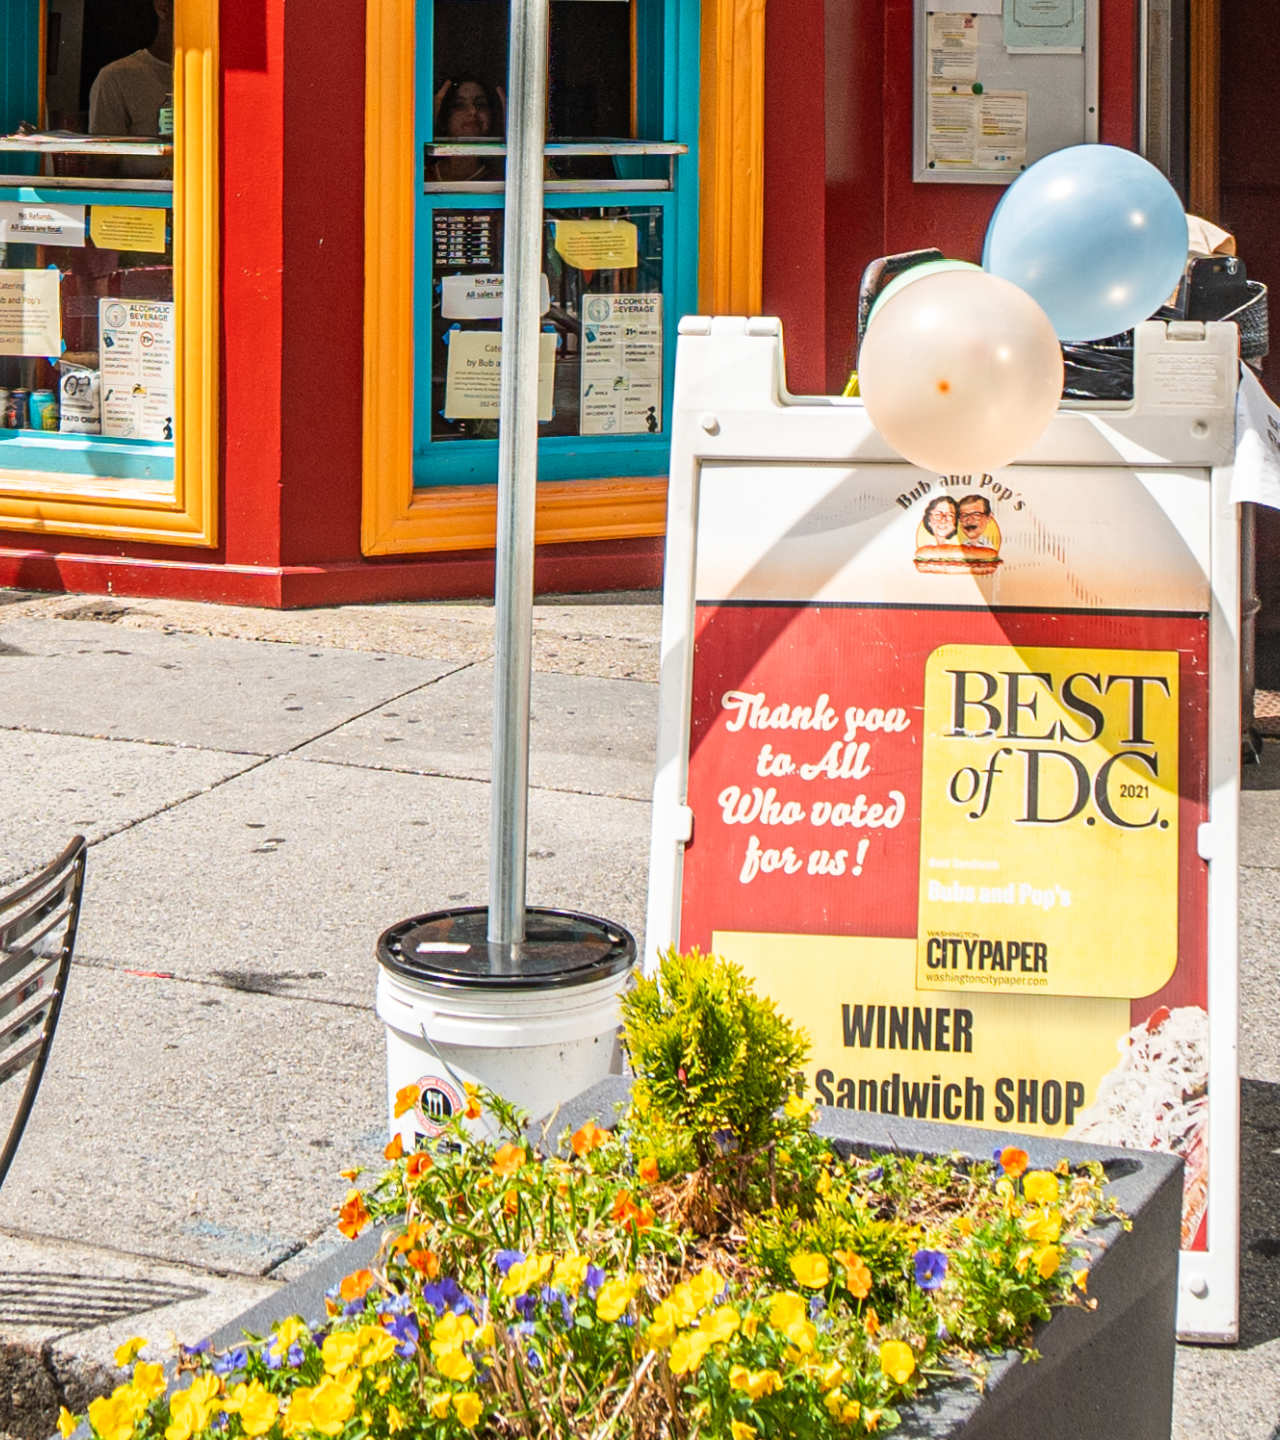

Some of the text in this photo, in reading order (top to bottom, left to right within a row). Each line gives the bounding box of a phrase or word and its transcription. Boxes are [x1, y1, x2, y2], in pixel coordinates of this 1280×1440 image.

[896, 480, 931, 509] Bub
[980, 472, 1026, 511] Pop's
[721, 690, 911, 742] Thank you
[943, 669, 1171, 746] BEST
[756, 740, 870, 780] to All
[718, 785, 906, 828] Who voted
[948, 747, 1169, 828] of D.C.
[1119, 784, 1149, 799] 2021
[739, 834, 802, 884] for
[927, 878, 1071, 911] Bubs and Pop's
[927, 929, 980, 939] WASHINGTON
[926, 937, 1049, 973] CITYPAPER
[926, 972, 1049, 987] washingtoncitypaper.com
[841, 1003, 974, 1054] WINNER
[815, 1068, 985, 1122] Sandwich
[995, 1076, 1086, 1127] SHOP
